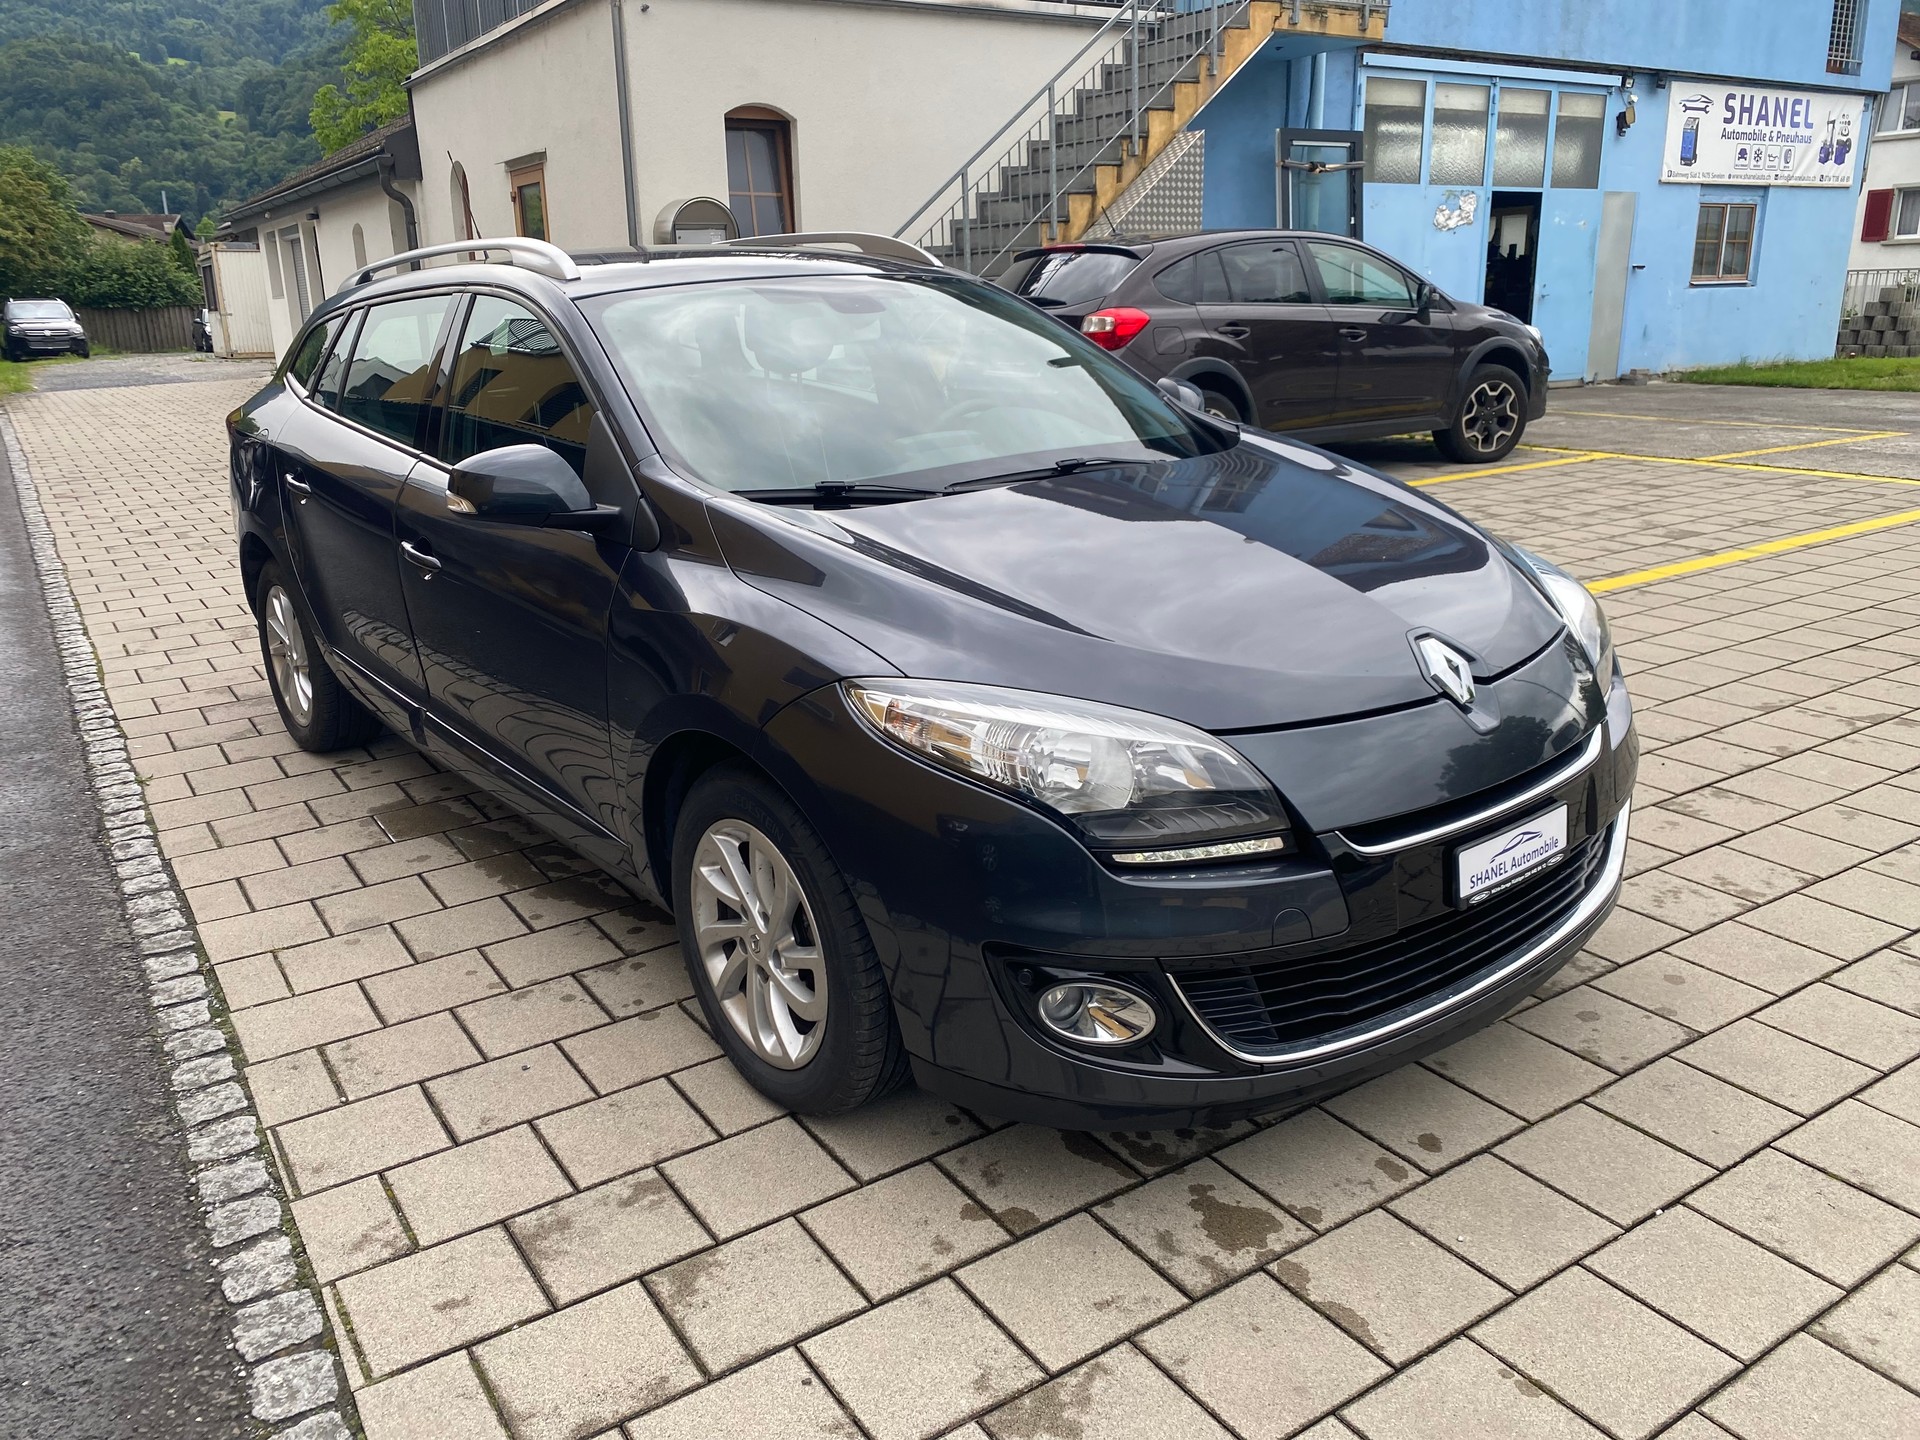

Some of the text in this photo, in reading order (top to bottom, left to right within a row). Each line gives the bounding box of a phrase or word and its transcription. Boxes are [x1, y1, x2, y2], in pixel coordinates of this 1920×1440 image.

[1722, 92, 1814, 130] SHANEL
[1720, 127, 1813, 144] Automobile & Pneuhaus
[1470, 860, 1508, 889] SHANEL
[1510, 836, 1559, 871] Automobile
